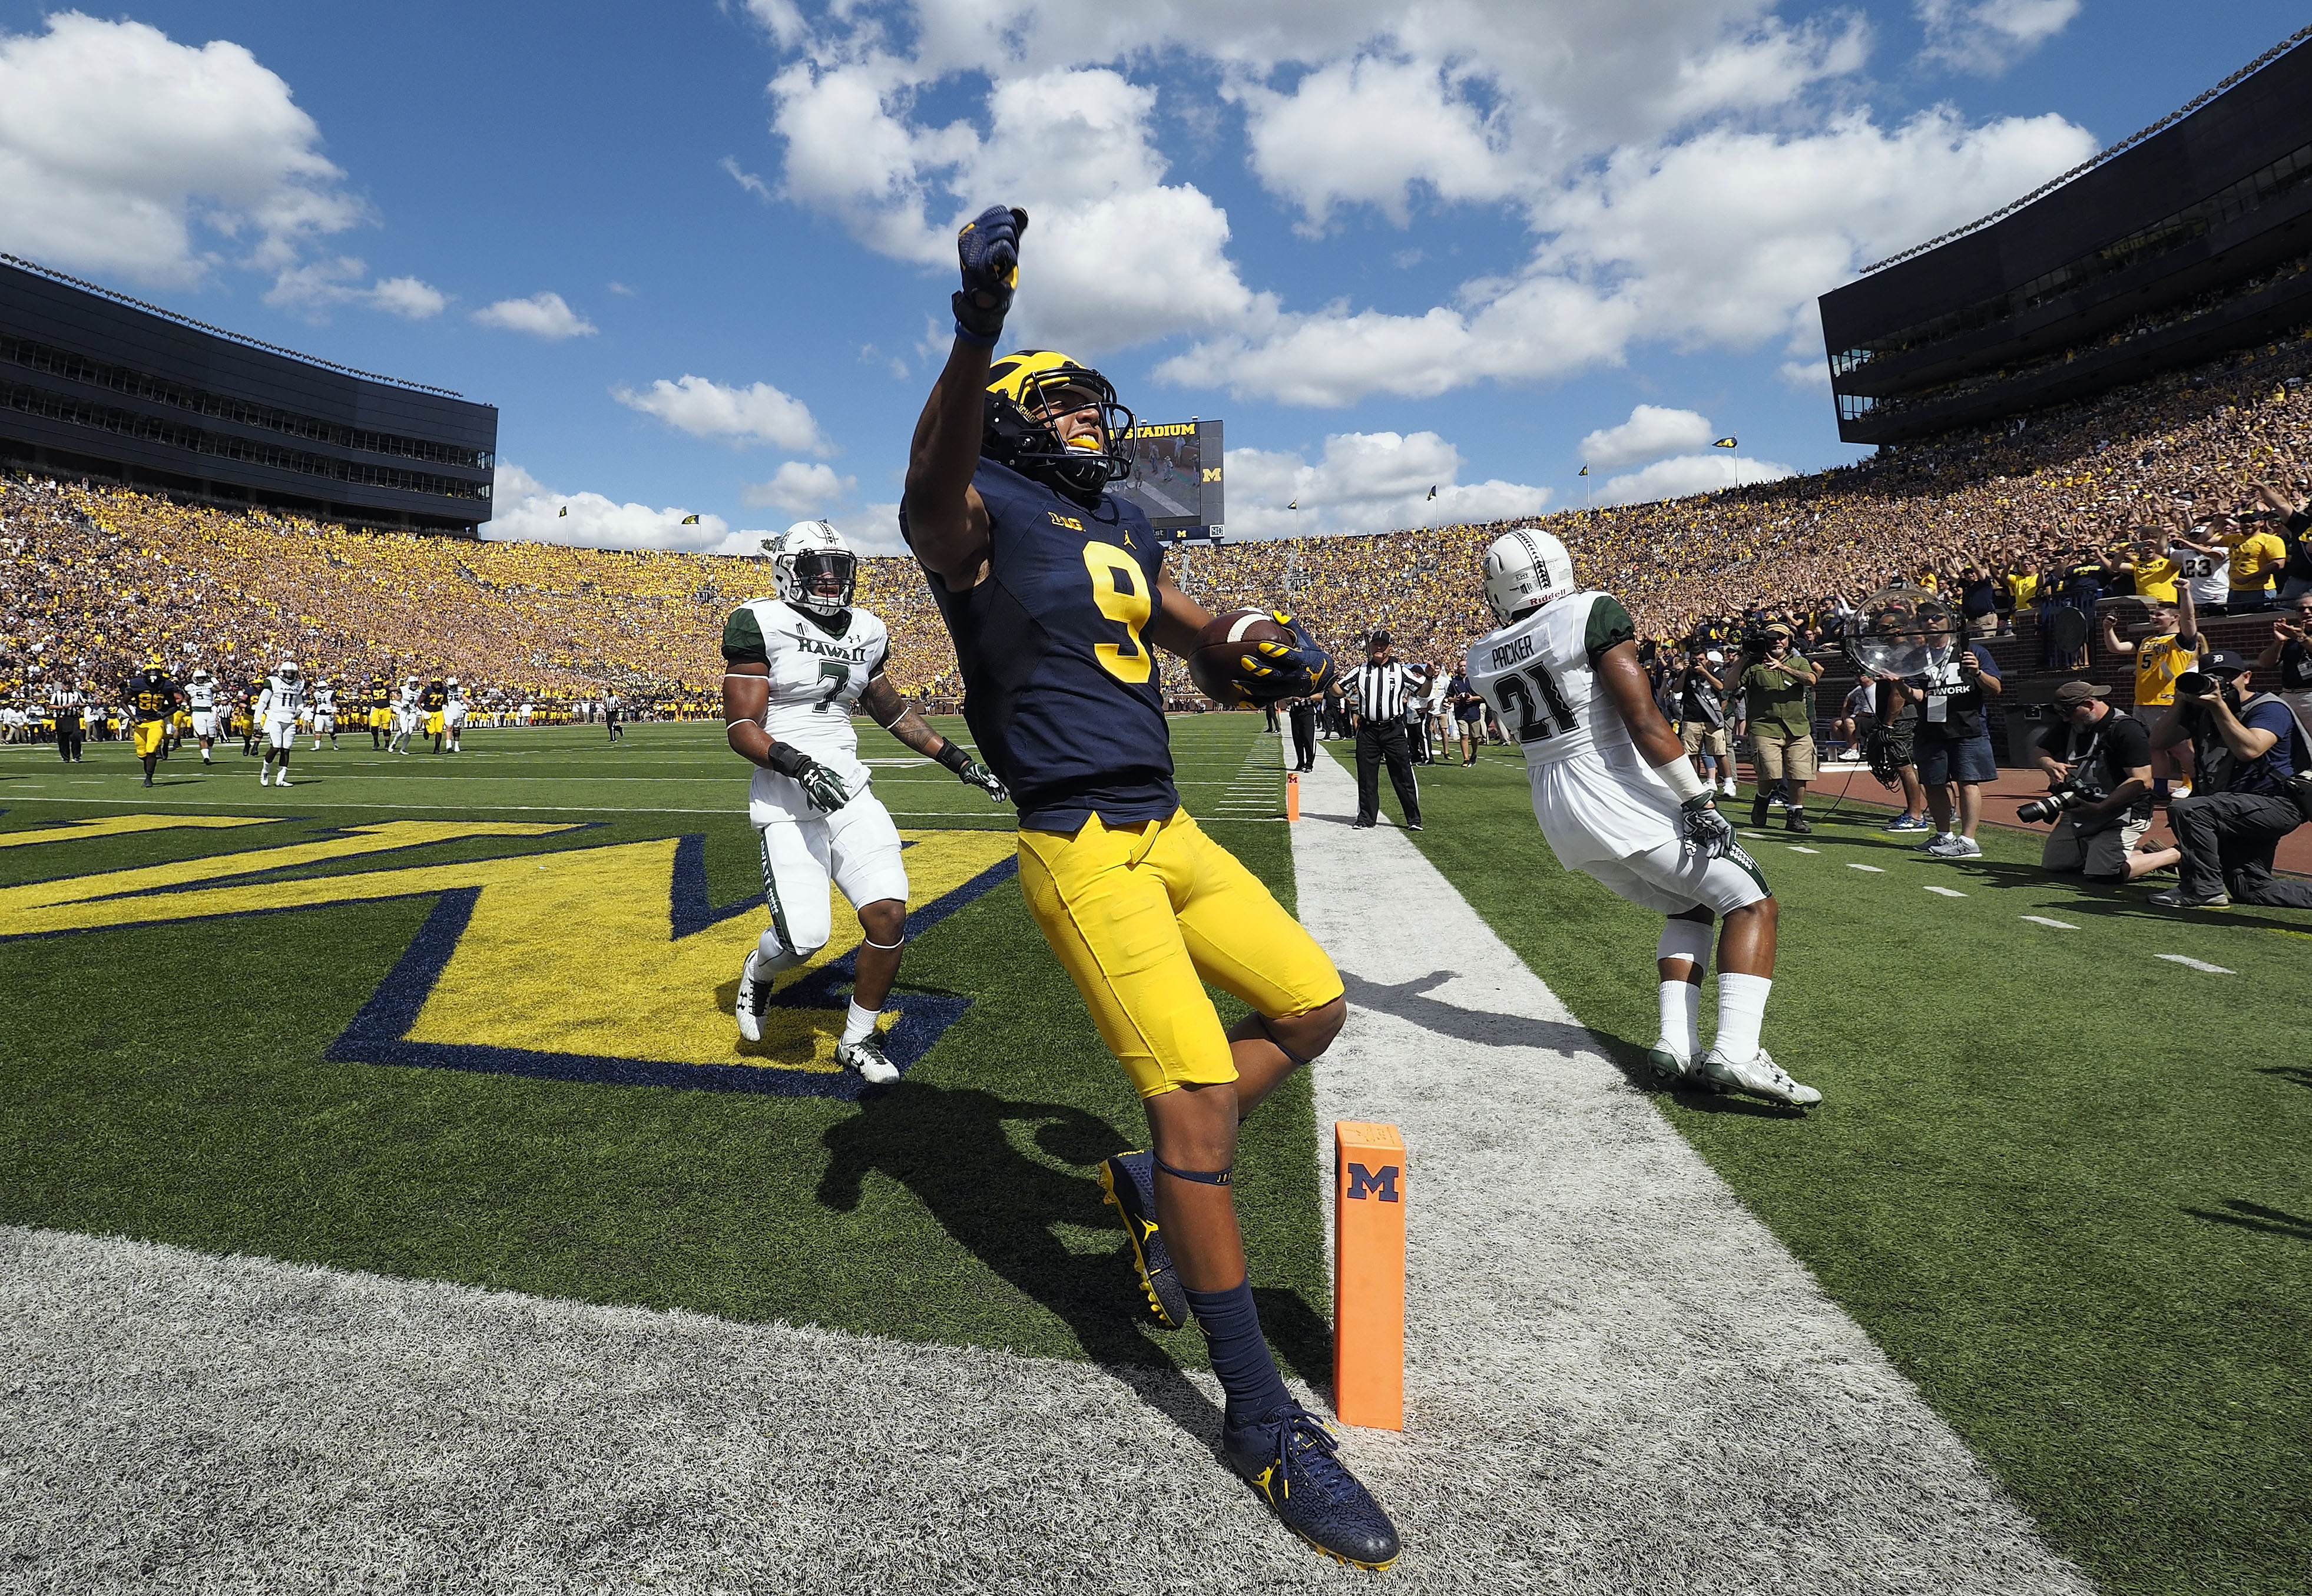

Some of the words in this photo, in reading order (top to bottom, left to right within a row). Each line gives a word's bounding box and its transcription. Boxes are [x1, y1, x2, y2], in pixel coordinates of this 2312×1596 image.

[1124, 423, 1195, 440] STADIUM
[1203, 468, 1221, 482] M
[2185, 559, 2212, 578] 23
[1529, 588, 1566, 605] Riddell
[1082, 540, 1151, 683] 9
[1492, 634, 1535, 670] PACKER
[373, 688, 387, 700] 52
[812, 659, 850, 714] 7
[138, 692, 165, 711] 86
[196, 691, 204, 700] 5
[281, 693, 293, 707] 11
[317, 697, 327, 705] 94
[429, 694, 444, 706] 77
[1493, 660, 1581, 744] 21
[1347, 1162, 1399, 1203] M
